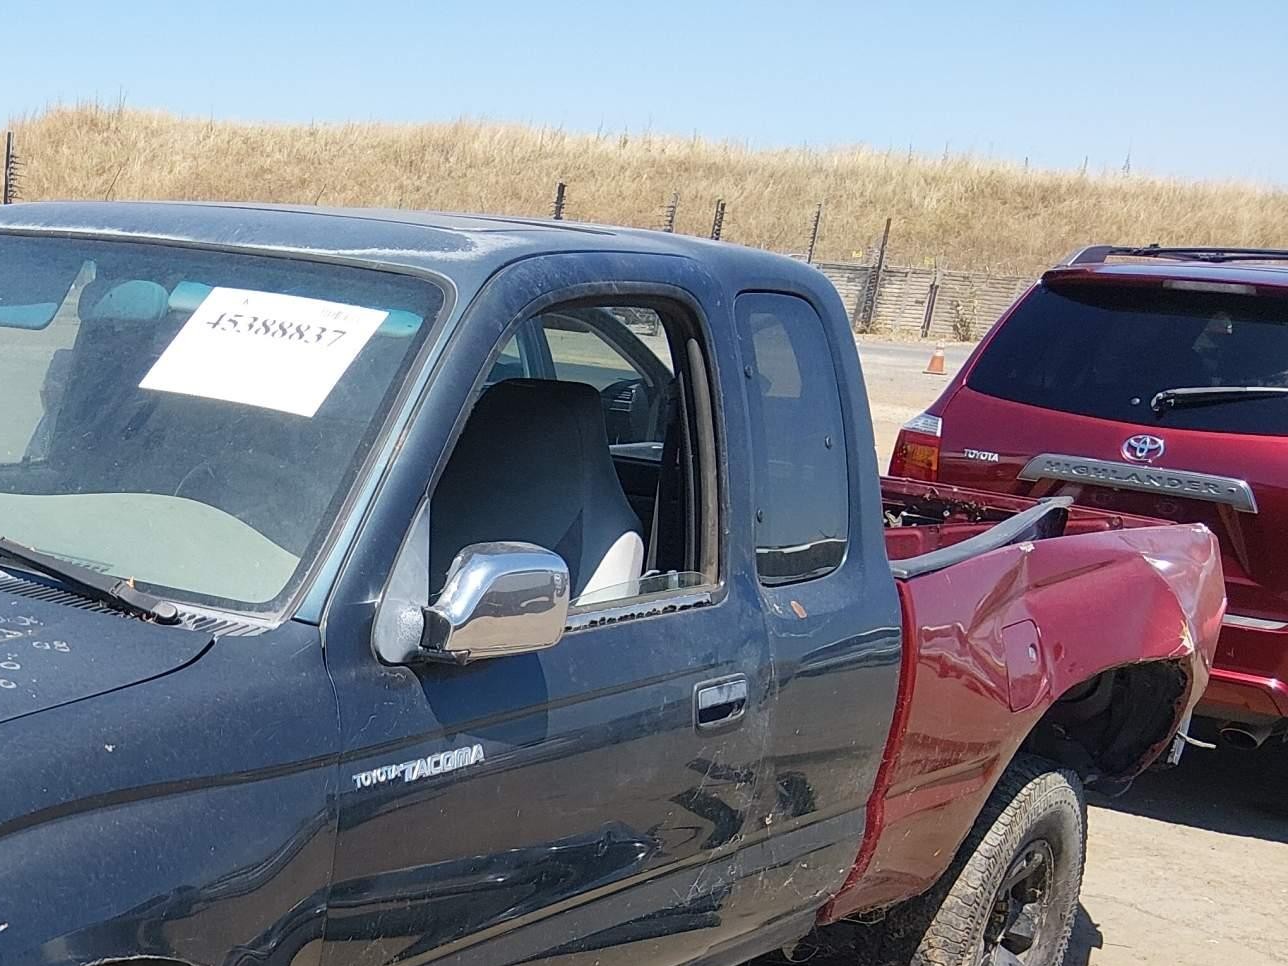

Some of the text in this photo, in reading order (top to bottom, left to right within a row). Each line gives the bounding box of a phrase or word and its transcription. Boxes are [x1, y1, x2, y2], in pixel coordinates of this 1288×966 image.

[206, 311, 347, 347] 45388837
[963, 448, 1000, 463] TOYOTA
[1043, 459, 1222, 495] HIGHLANDER
[351, 743, 486, 789] TOYOTA TACOMA
